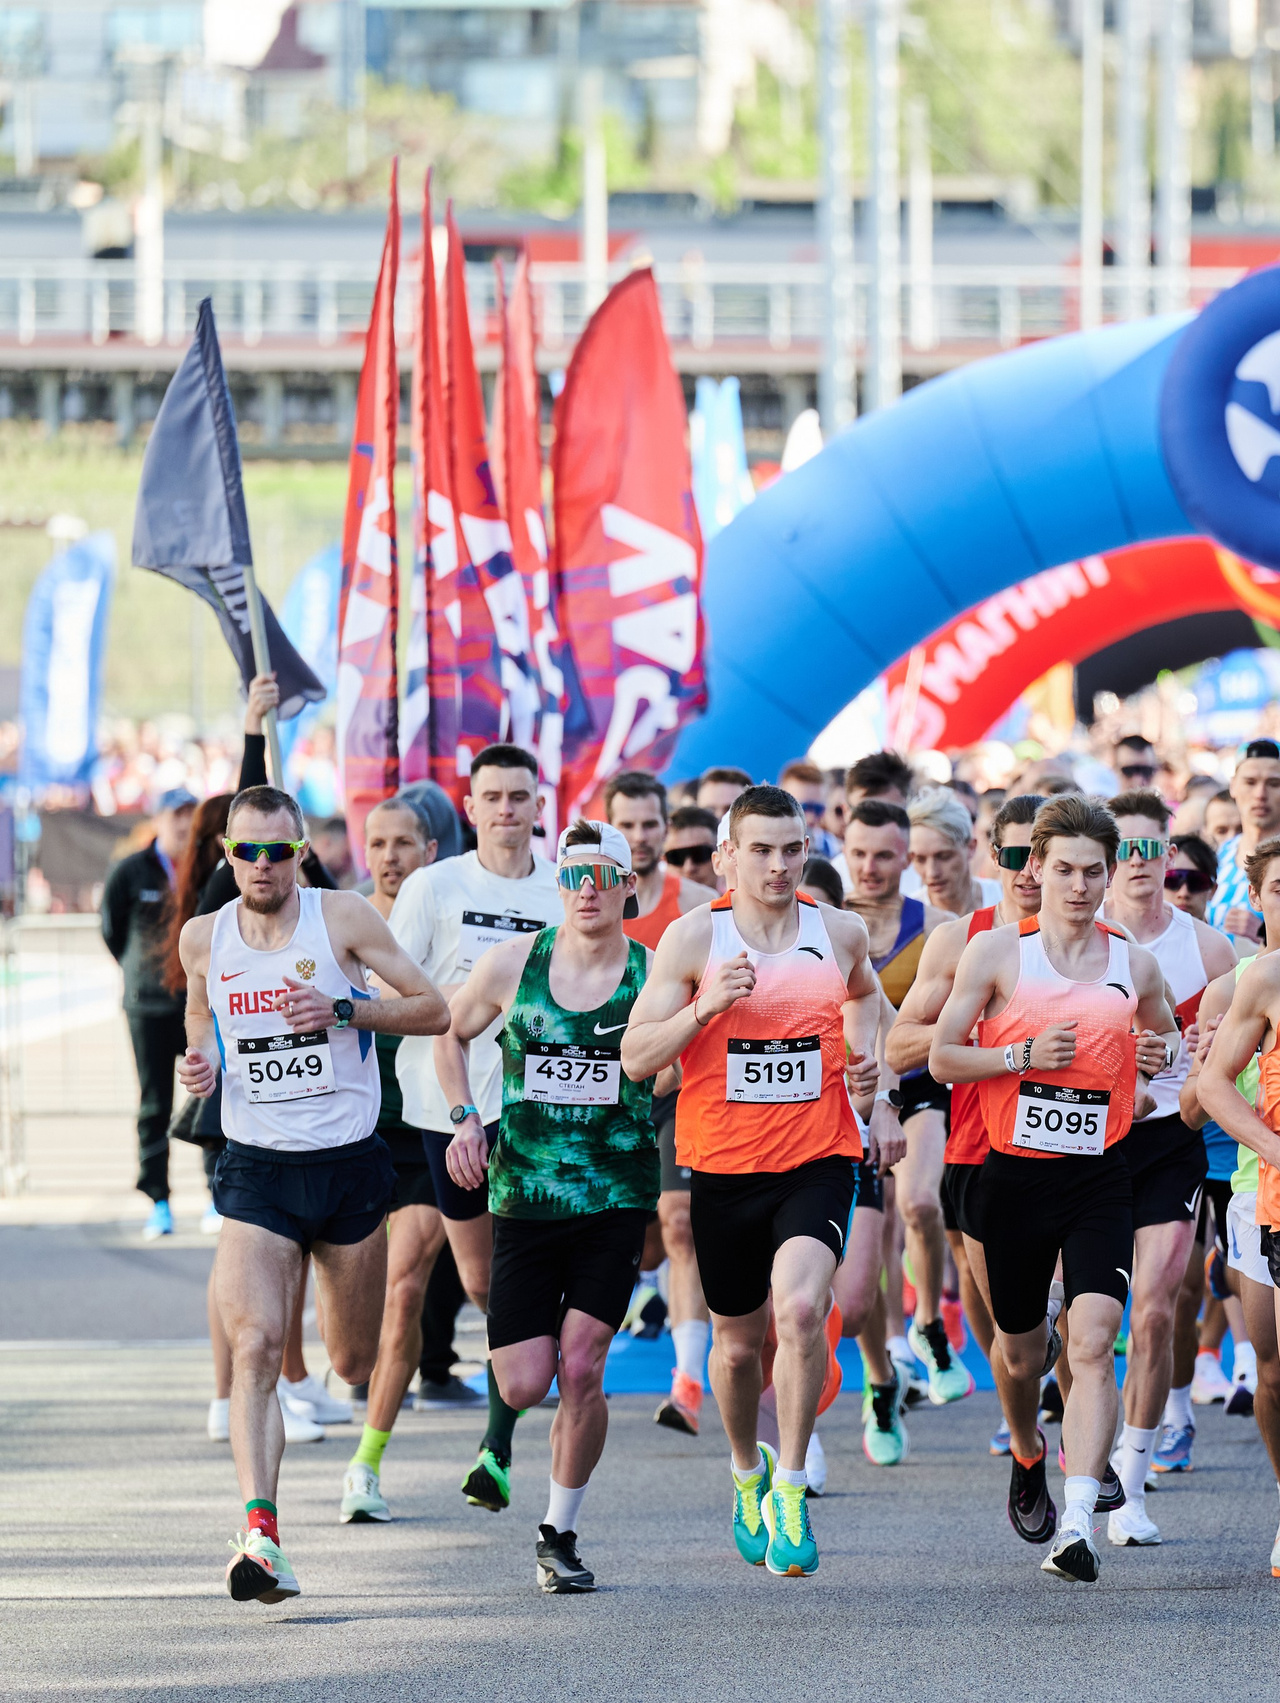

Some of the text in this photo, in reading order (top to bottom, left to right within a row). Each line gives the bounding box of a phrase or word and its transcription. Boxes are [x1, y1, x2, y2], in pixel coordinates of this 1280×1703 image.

[247, 1042, 256, 1050] 10
[248, 1054, 323, 1083] 5049
[536, 1059, 608, 1083] 4375
[744, 1060, 806, 1084] 5191
[1033, 1086, 1042, 1094] 10
[1055, 1091, 1080, 1100] SOCHI
[1025, 1105, 1099, 1136] 5095
